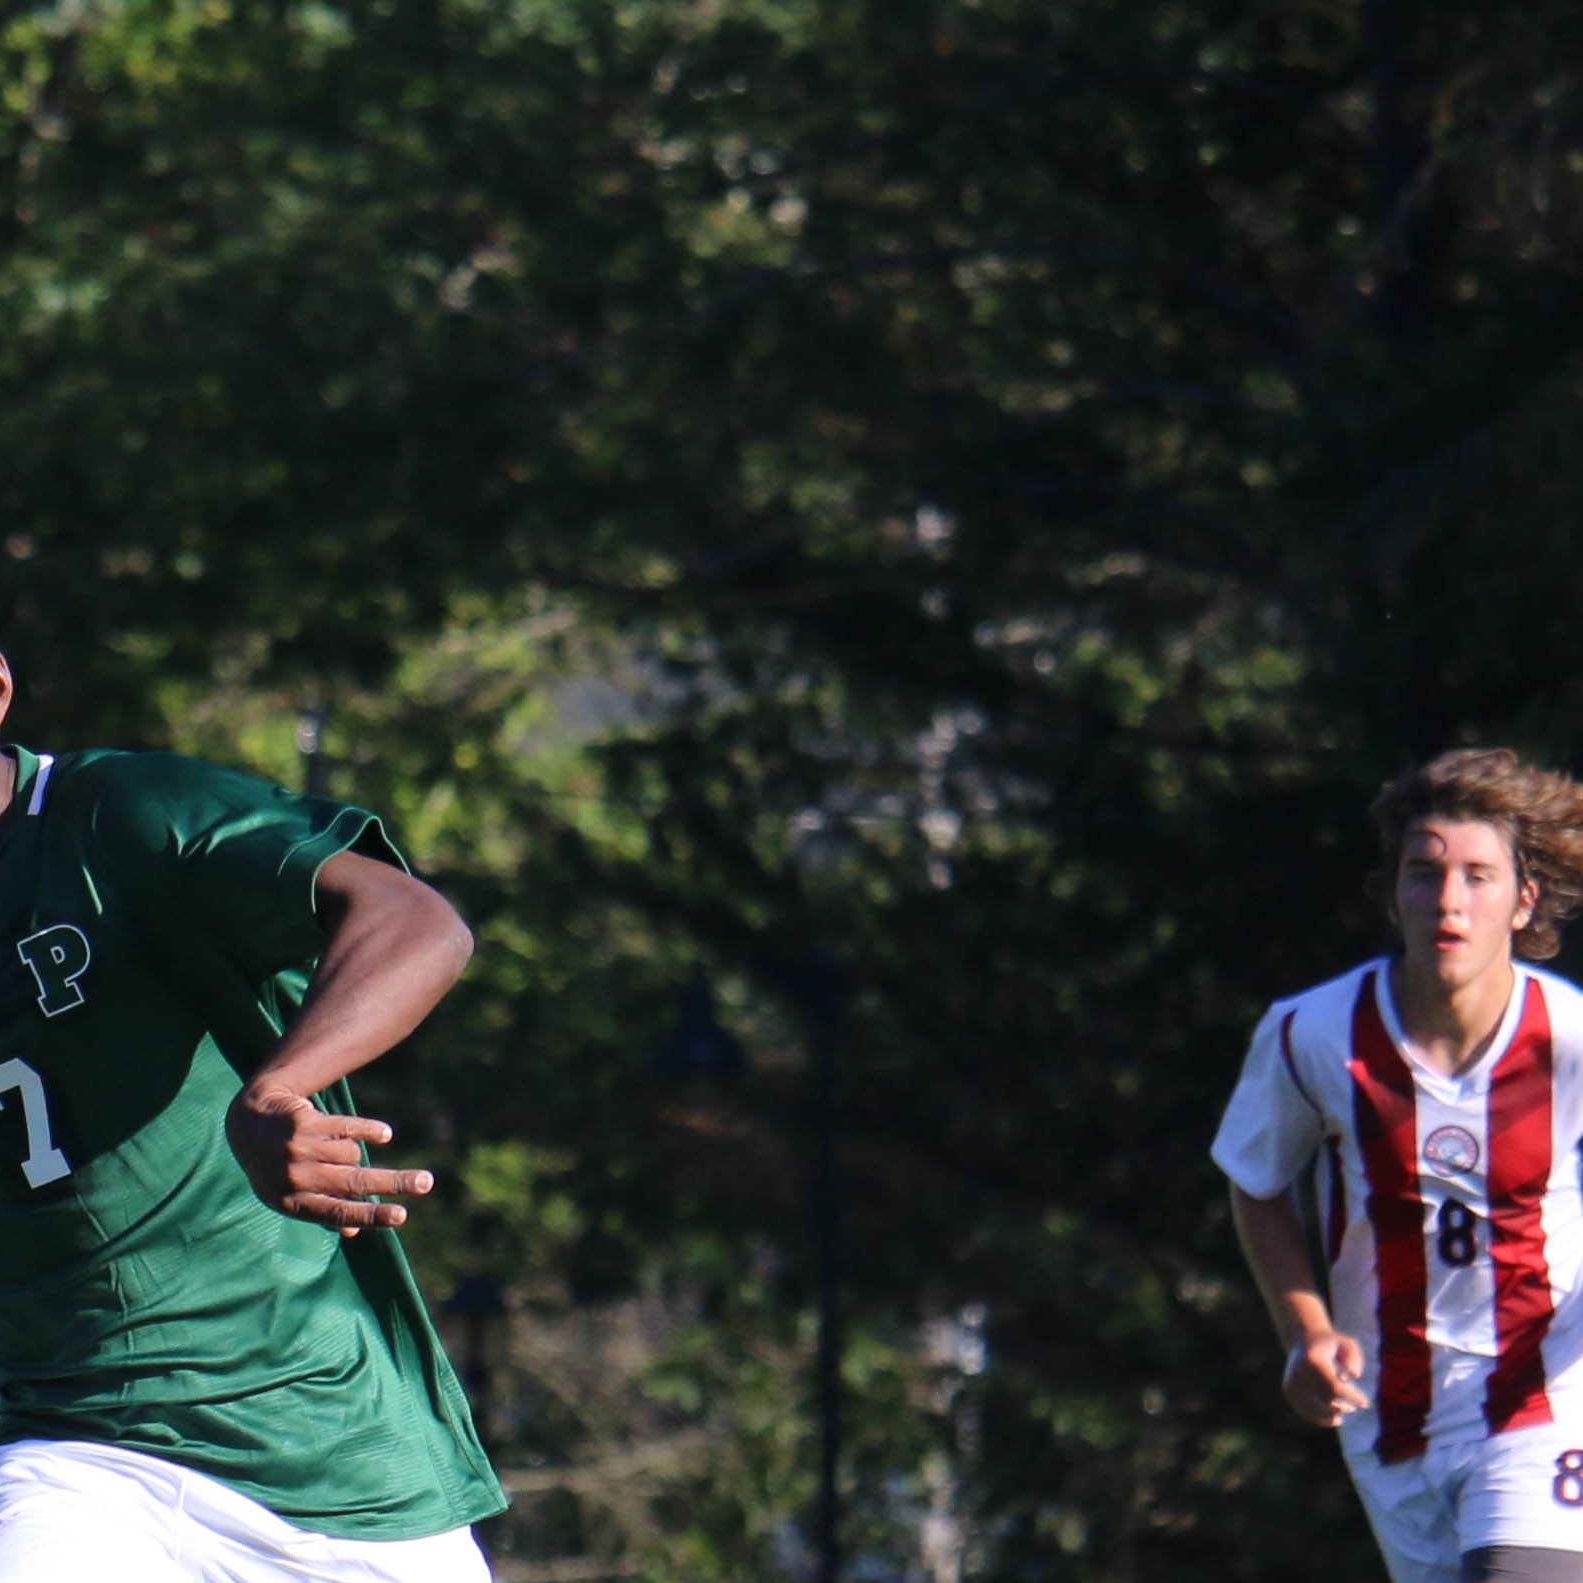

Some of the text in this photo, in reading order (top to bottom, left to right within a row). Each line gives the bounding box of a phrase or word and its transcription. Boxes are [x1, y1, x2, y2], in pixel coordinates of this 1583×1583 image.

[17, 923, 90, 1017] P
[1438, 1199, 1477, 1267] 8
[1553, 1449, 1583, 1508] 8
